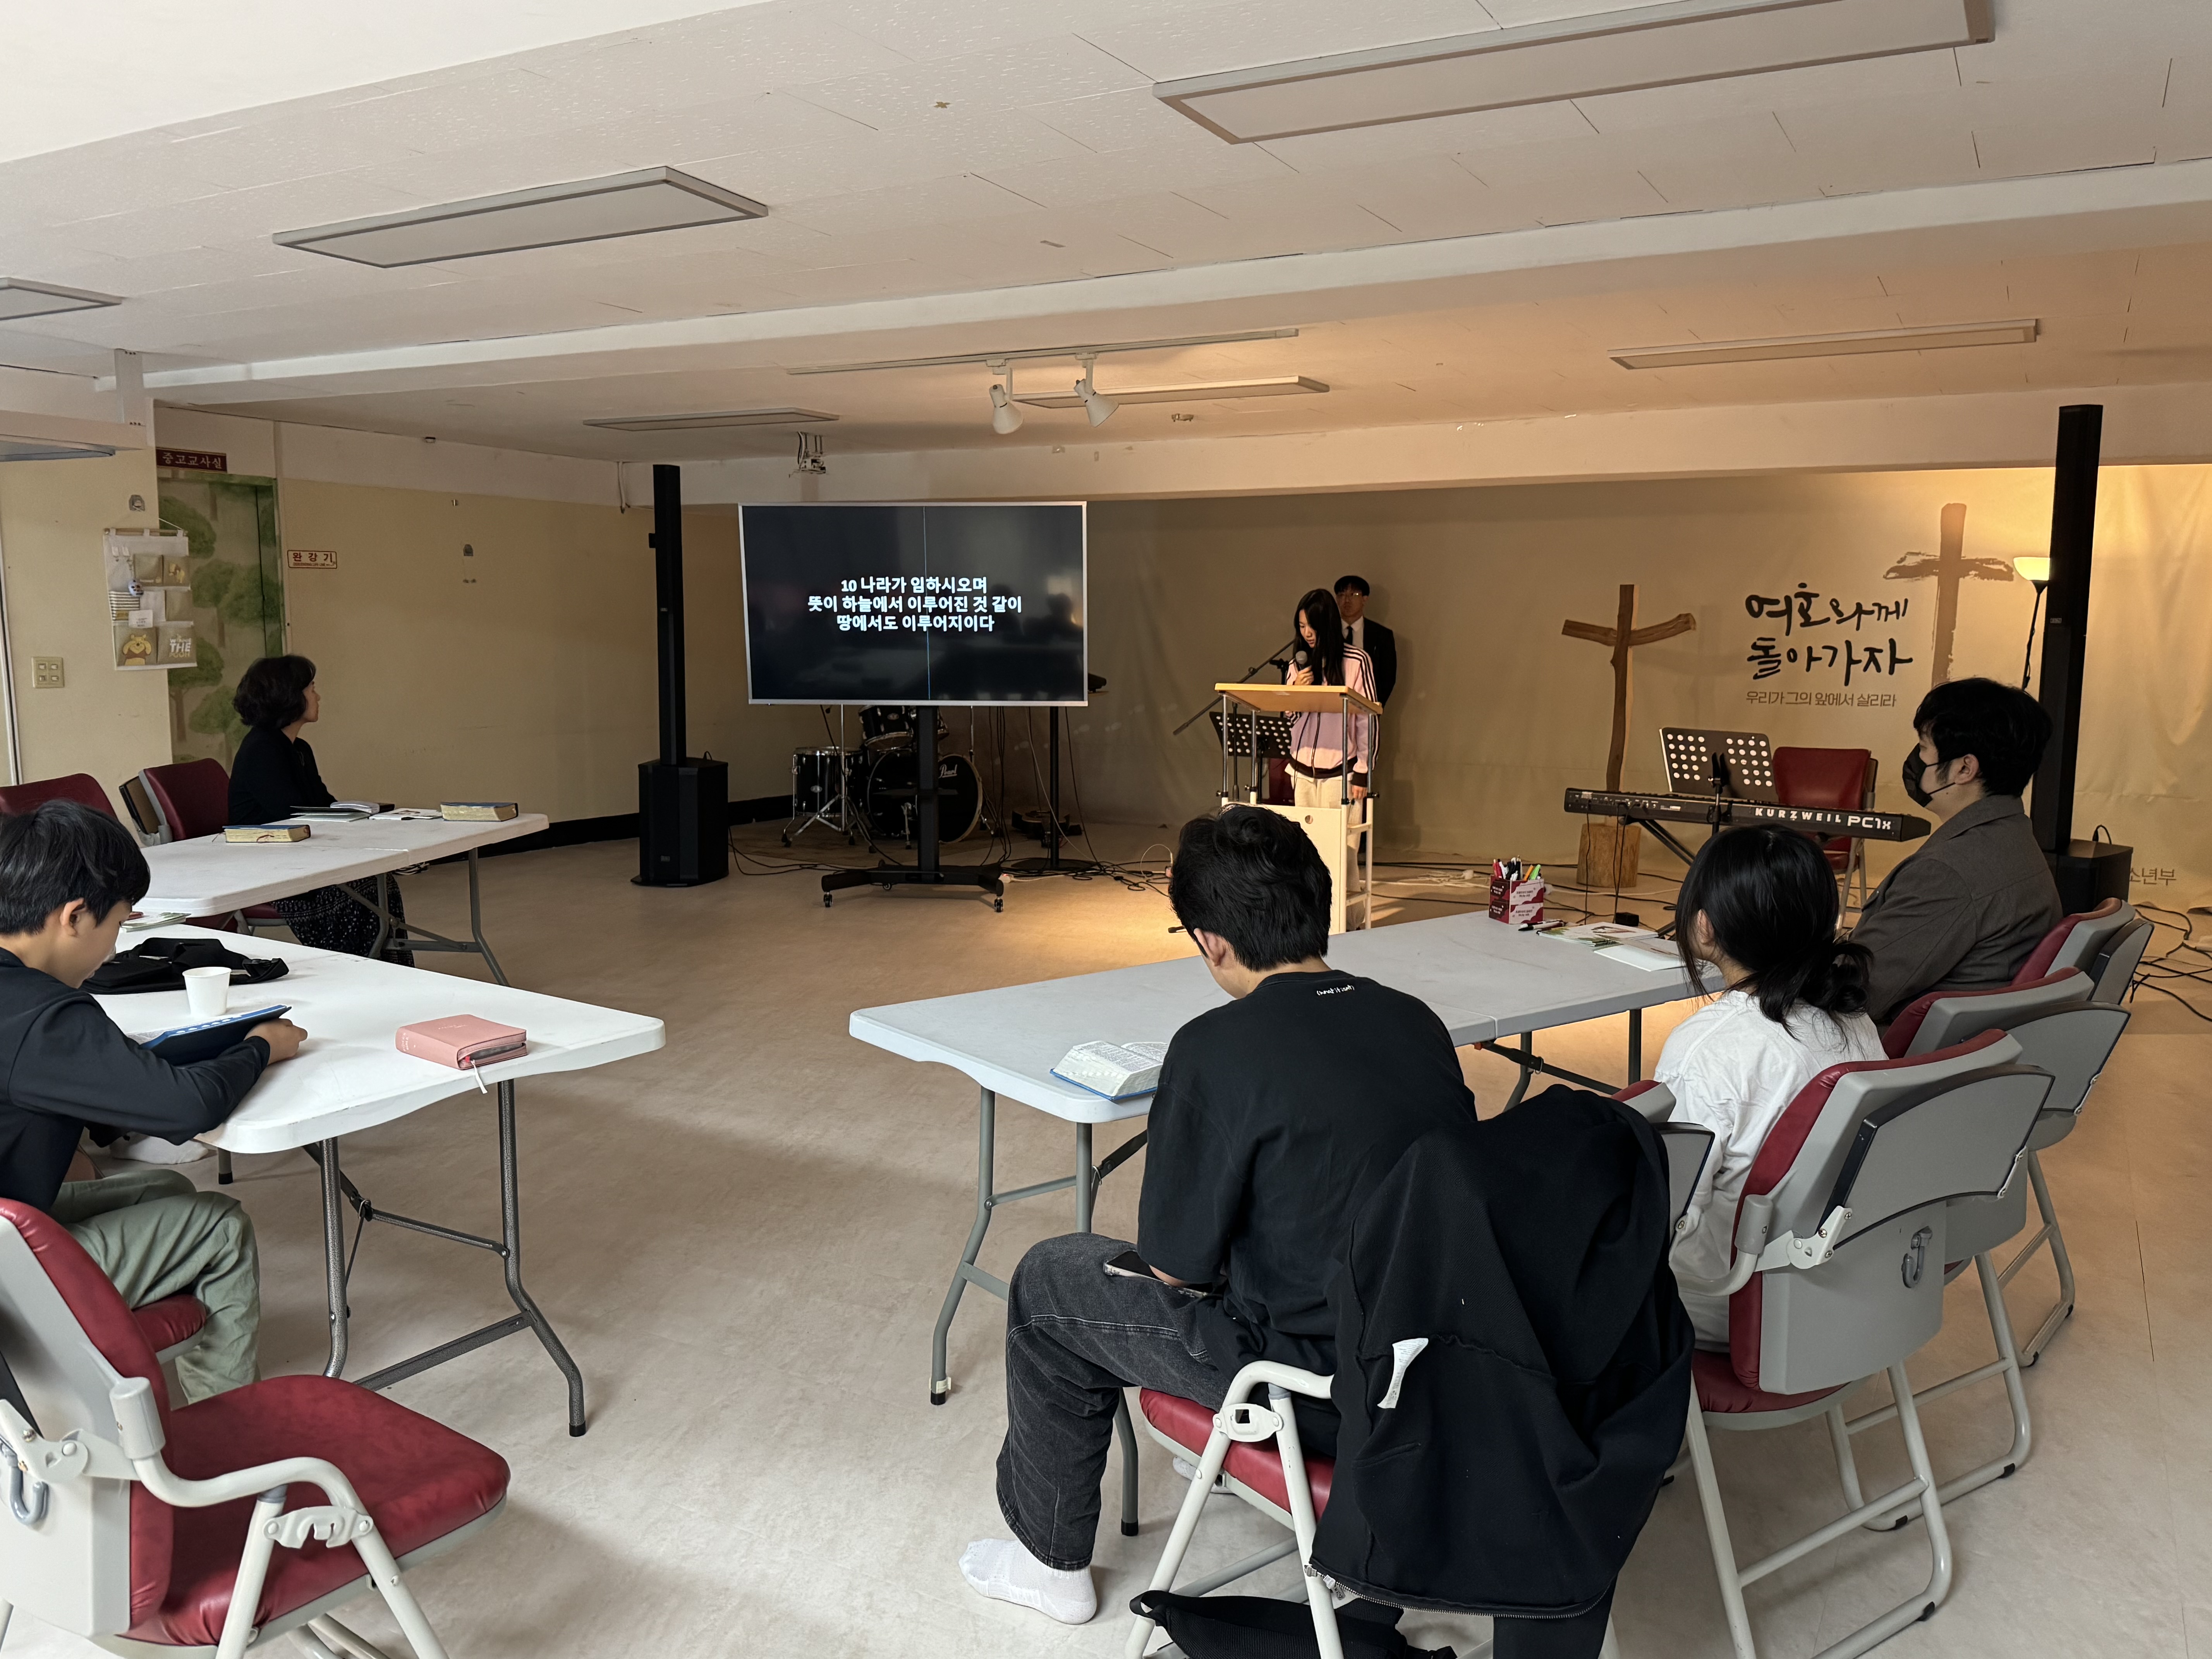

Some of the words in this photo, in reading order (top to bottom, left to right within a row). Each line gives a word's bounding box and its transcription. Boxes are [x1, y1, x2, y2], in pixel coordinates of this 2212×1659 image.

[162, 452, 222, 469] 중고교사실
[841, 580, 857, 592] 10
[860, 576, 907, 594] 나라가
[910, 576, 987, 594] 임하시오며
[807, 595, 838, 613] 뜻이
[842, 595, 903, 613] 하늘에서
[907, 595, 968, 613] 이루어진
[973, 596, 988, 613] 것
[992, 596, 1022, 613] 같이
[1745, 582, 1908, 636] 여호와께
[837, 614, 898, 632] 땅에서도
[902, 615, 995, 632] 이루어지이다
[170, 642, 191, 653] THE
[1747, 637, 1913, 687] 돌아가자
[1746, 691, 1784, 704] 우리가
[1785, 692, 1812, 705] 그의
[1815, 692, 1854, 706] 앞에서
[1857, 694, 1897, 707] 살리라
[1755, 807, 1841, 823] KURZWEIL
